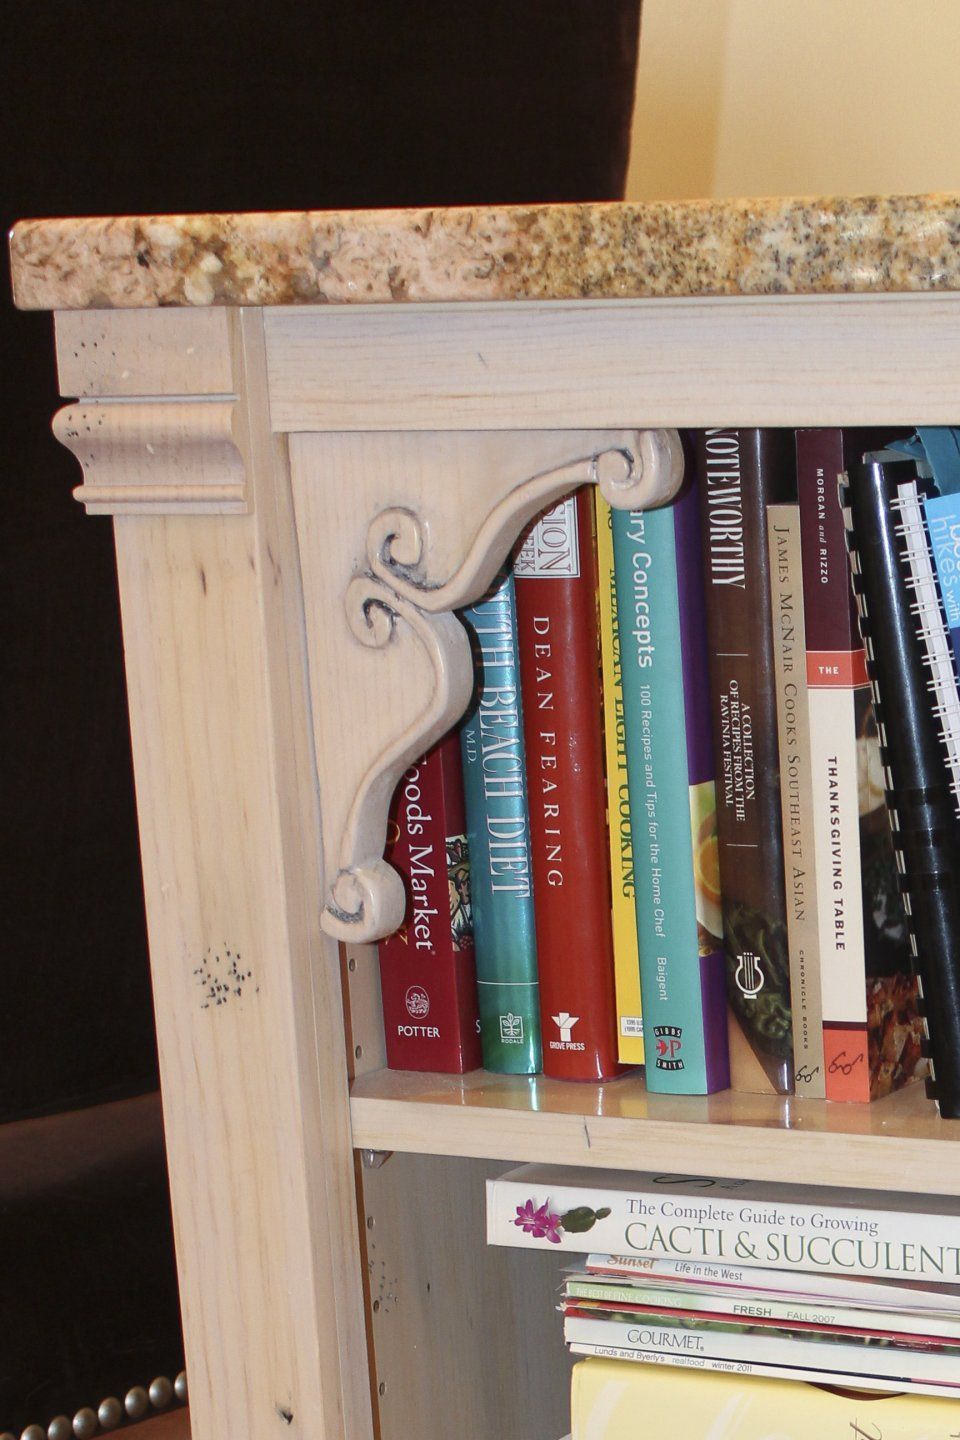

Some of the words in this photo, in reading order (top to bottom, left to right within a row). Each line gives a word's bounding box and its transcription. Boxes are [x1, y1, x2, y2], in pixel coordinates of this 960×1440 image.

[816, 468, 825, 519] MORGAN
[818, 525, 828, 543] and
[931, 515, 958, 587] hikes
[819, 549, 829, 584] RIZZO
[632, 552, 655, 669] Concepts
[533, 616, 554, 710] DEAN
[818, 666, 839, 675] THE
[640, 684, 651, 706] 100
[729, 680, 739, 696] OF
[720, 694, 731, 747] RAVINIA
[730, 699, 742, 752] RECIPES
[742, 703, 751, 716] A
[465, 729, 478, 763] M.D.
[479, 685, 525, 800] BEACH
[641, 710, 653, 760] Recipes
[645, 764, 656, 788] and
[733, 754, 744, 795] FROM
[743, 718, 756, 800] COLLECTION
[723, 750, 734, 807] FESTIVAL
[539, 731, 564, 887] FEARING
[645, 791, 657, 817] Tips
[736, 798, 746, 822] THE
[648, 820, 658, 841] for
[827, 755, 843, 889] THANKSGIVING
[486, 813, 534, 899] DIET
[618, 784, 636, 899] COOKING
[649, 843, 659, 863] the
[408, 843, 438, 952] Market
[650, 868, 662, 904] Home
[654, 909, 666, 938] Chef
[833, 898, 846, 950] TABLE
[656, 956, 668, 1001] Baigent
[799, 950, 807, 1010] CHRONICLE
[397, 1025, 440, 1038] POTTER
[550, 1041, 566, 1050] GROVE
[567, 1042, 585, 1051] PRESS
[654, 1027, 681, 1036] GIBBS
[657, 1059, 683, 1069] SMITH
[626, 1198, 656, 1216] The
[660, 1203, 735, 1224] Complete
[739, 1207, 786, 1226] Guide
[790, 1214, 806, 1227] to
[810, 1213, 879, 1236] Growing
[624, 1222, 723, 1256] CACTI
[734, 1231, 761, 1261] &
[607, 1253, 659, 1270] Sunset
[674, 1262, 691, 1274] Life
[693, 1265, 702, 1275] in
[704, 1266, 719, 1277] the
[721, 1268, 743, 1281] West
[733, 1304, 772, 1317] FRESH
[787, 1311, 810, 1321] FALL
[812, 1313, 836, 1324] 2007
[627, 1329, 701, 1350] GOURMET
[594, 1346, 618, 1356] Lunds
[619, 1348, 634, 1358] and
[636, 1350, 665, 1363] Byerly's
[711, 1360, 735, 1371] winter
[737, 1363, 752, 1373] 2011
